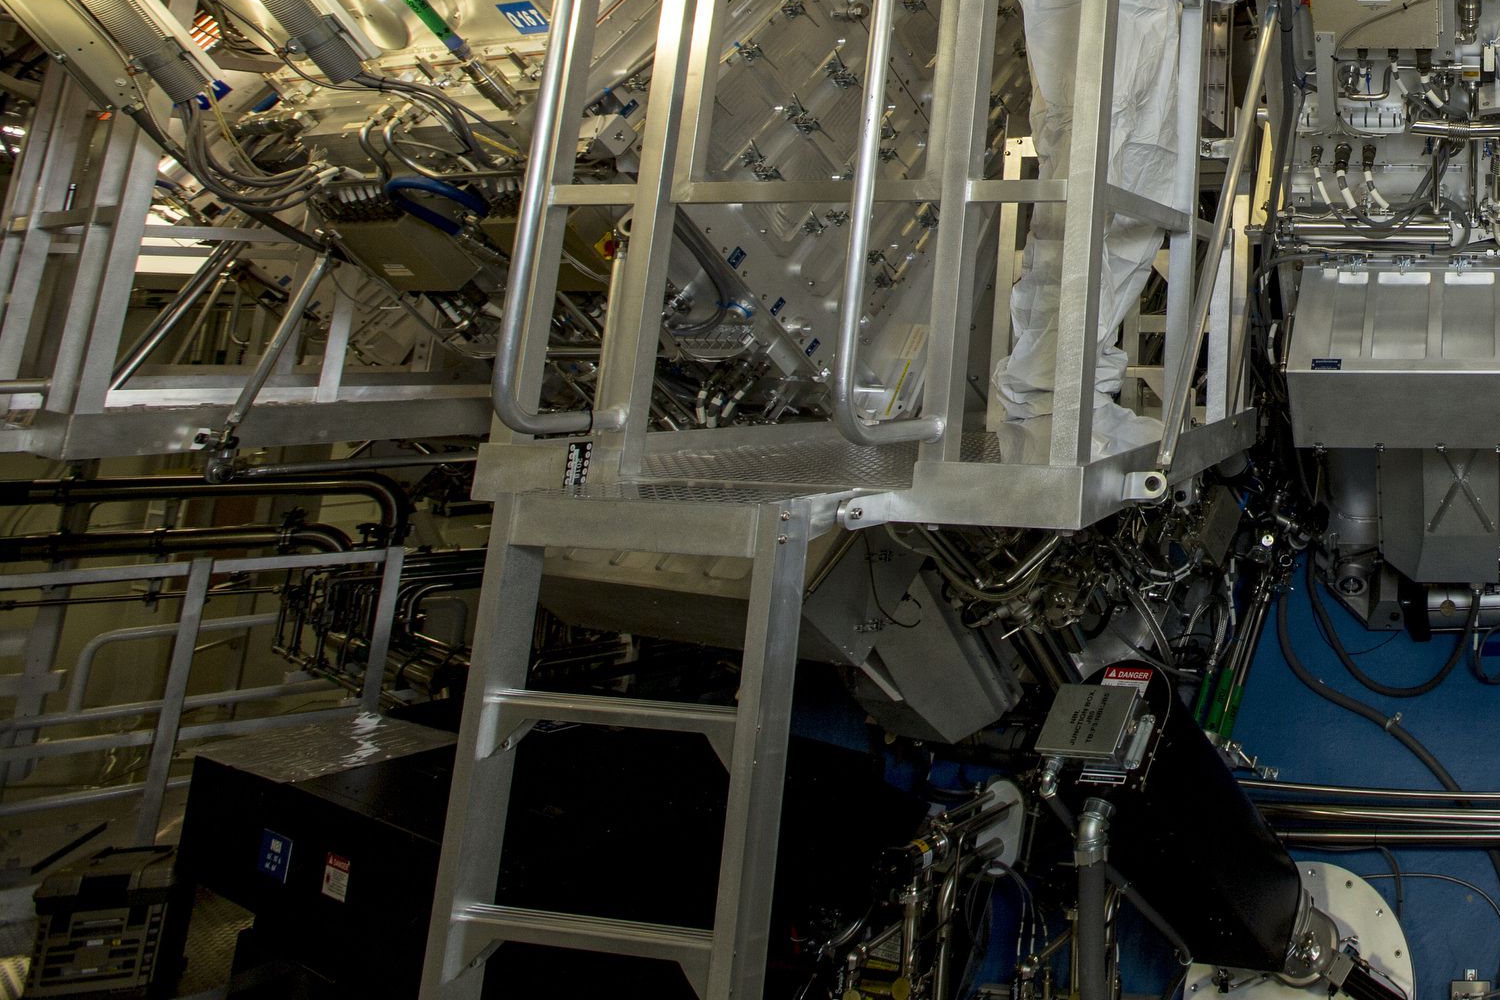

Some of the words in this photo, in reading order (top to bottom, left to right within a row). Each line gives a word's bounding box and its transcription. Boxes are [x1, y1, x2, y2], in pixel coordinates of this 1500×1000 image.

[505, 12, 524, 28] Q
[517, 10, 538, 27] 16
[532, 9, 546, 25] T
[1117, 670, 1149, 680] DANGER
[1070, 708, 1088, 746] JUNCTION
